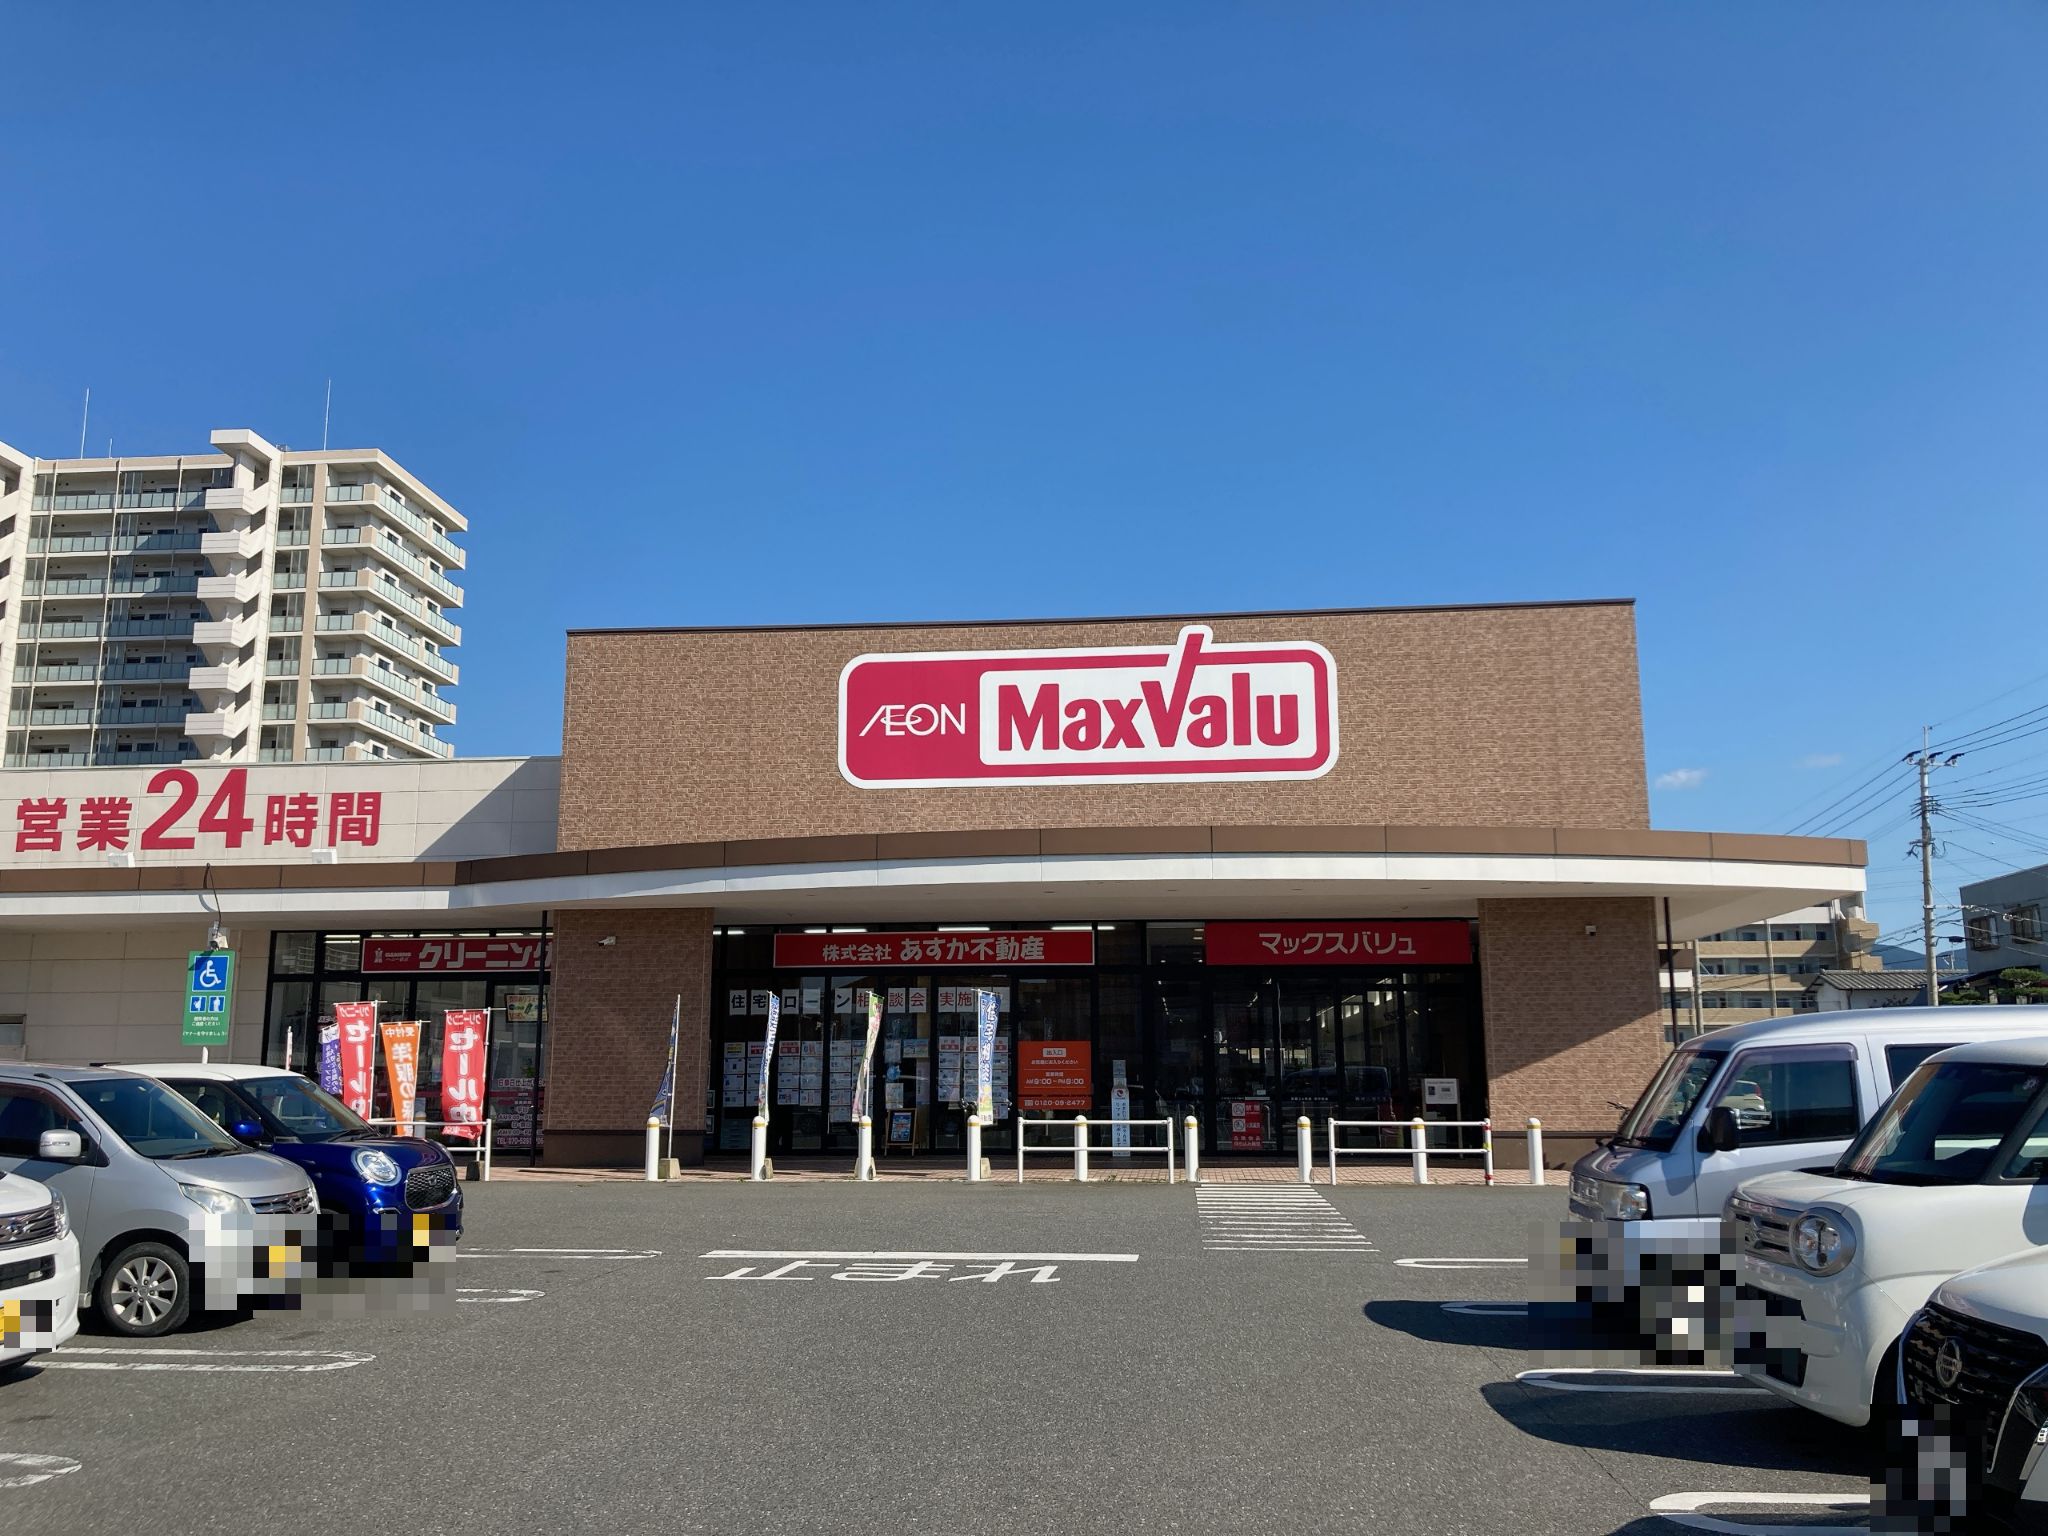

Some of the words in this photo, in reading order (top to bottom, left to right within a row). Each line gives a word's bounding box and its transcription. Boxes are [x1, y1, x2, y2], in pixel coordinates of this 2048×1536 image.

[998, 633, 1299, 751] MaxValu
[822, 943, 893, 962] 株式会社
[900, 936, 1045, 961] あすか不動産
[1258, 931, 1417, 955] マックスバリュ
[703, 1260, 1061, 1283] 止まれ
